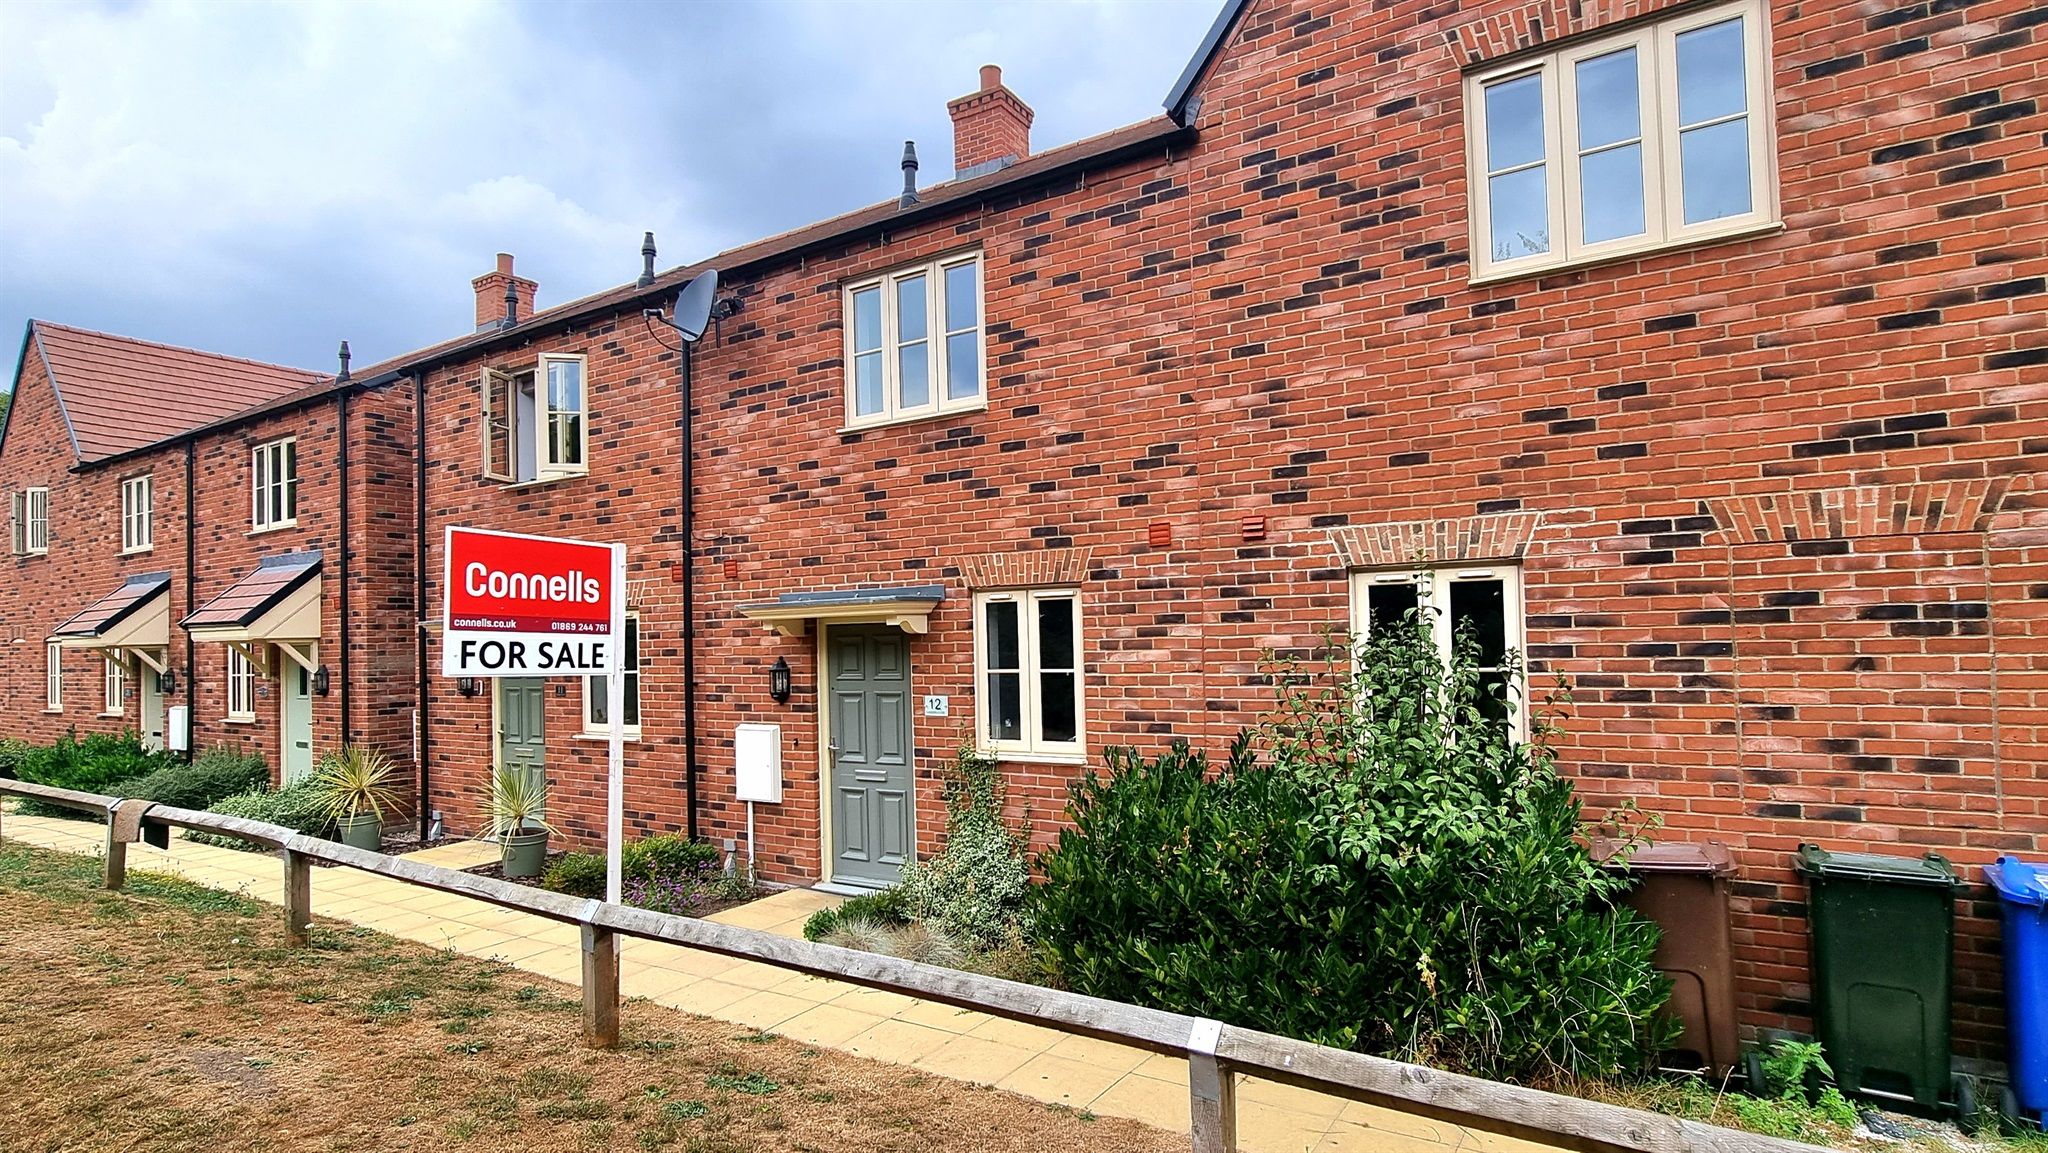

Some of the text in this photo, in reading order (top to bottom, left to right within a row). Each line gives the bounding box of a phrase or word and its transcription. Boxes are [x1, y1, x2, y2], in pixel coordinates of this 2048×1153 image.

[465, 561, 600, 604] Connells
[453, 618, 517, 629] connells.co.uk
[551, 622, 608, 632] 01869 244 761
[460, 640, 605, 669] FOR SALE
[929, 698, 941, 710] 12
